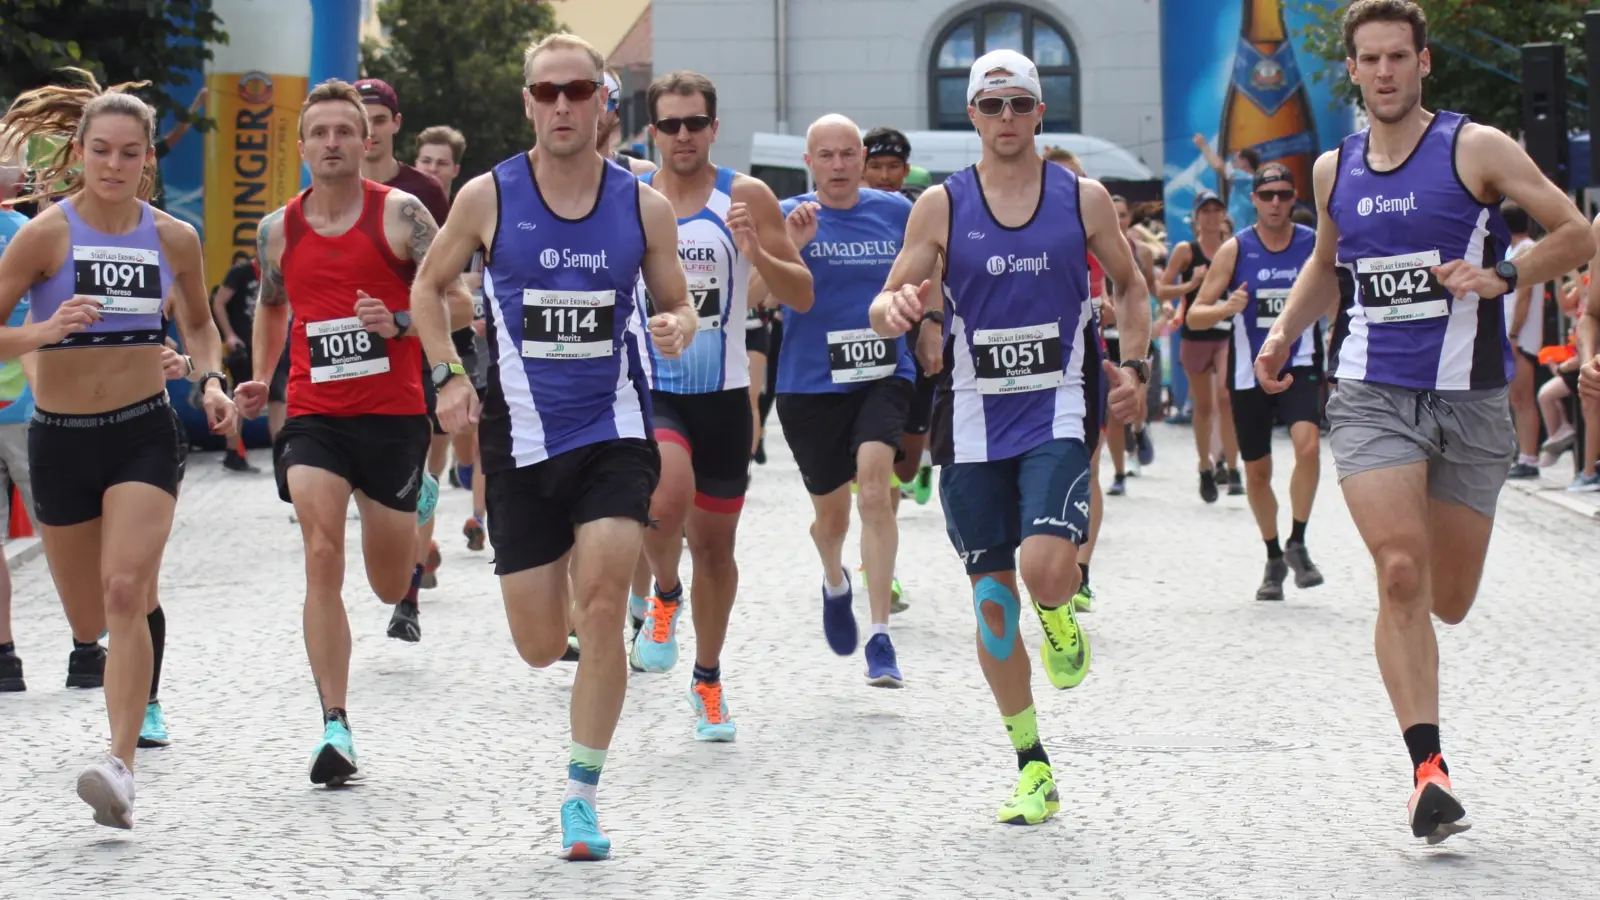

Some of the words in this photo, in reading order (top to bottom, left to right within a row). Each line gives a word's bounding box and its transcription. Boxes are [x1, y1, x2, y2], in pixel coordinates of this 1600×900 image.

[1359, 198, 1372, 215] LG
[1376, 191, 1418, 216] Sempt
[542, 249, 558, 267] LG
[563, 248, 609, 274] Sempt
[988, 257, 1004, 274] LG
[1008, 251, 1051, 276] Sempt
[91, 262, 145, 288] 1091
[1369, 269, 1431, 297] 1042
[106, 287, 132, 296] Theresa
[1390, 297, 1412, 305] Anton
[541, 308, 598, 333] 1114
[320, 330, 371, 358] 1018
[557, 333, 582, 342] Moritz
[332, 354, 362, 365] Benjamin
[841, 340, 886, 362] 1010
[988, 341, 1045, 369] 1051
[1006, 367, 1032, 376] Patrick
[62, 417, 98, 428] ARMOUR
[116, 403, 150, 423] ARMOUR
